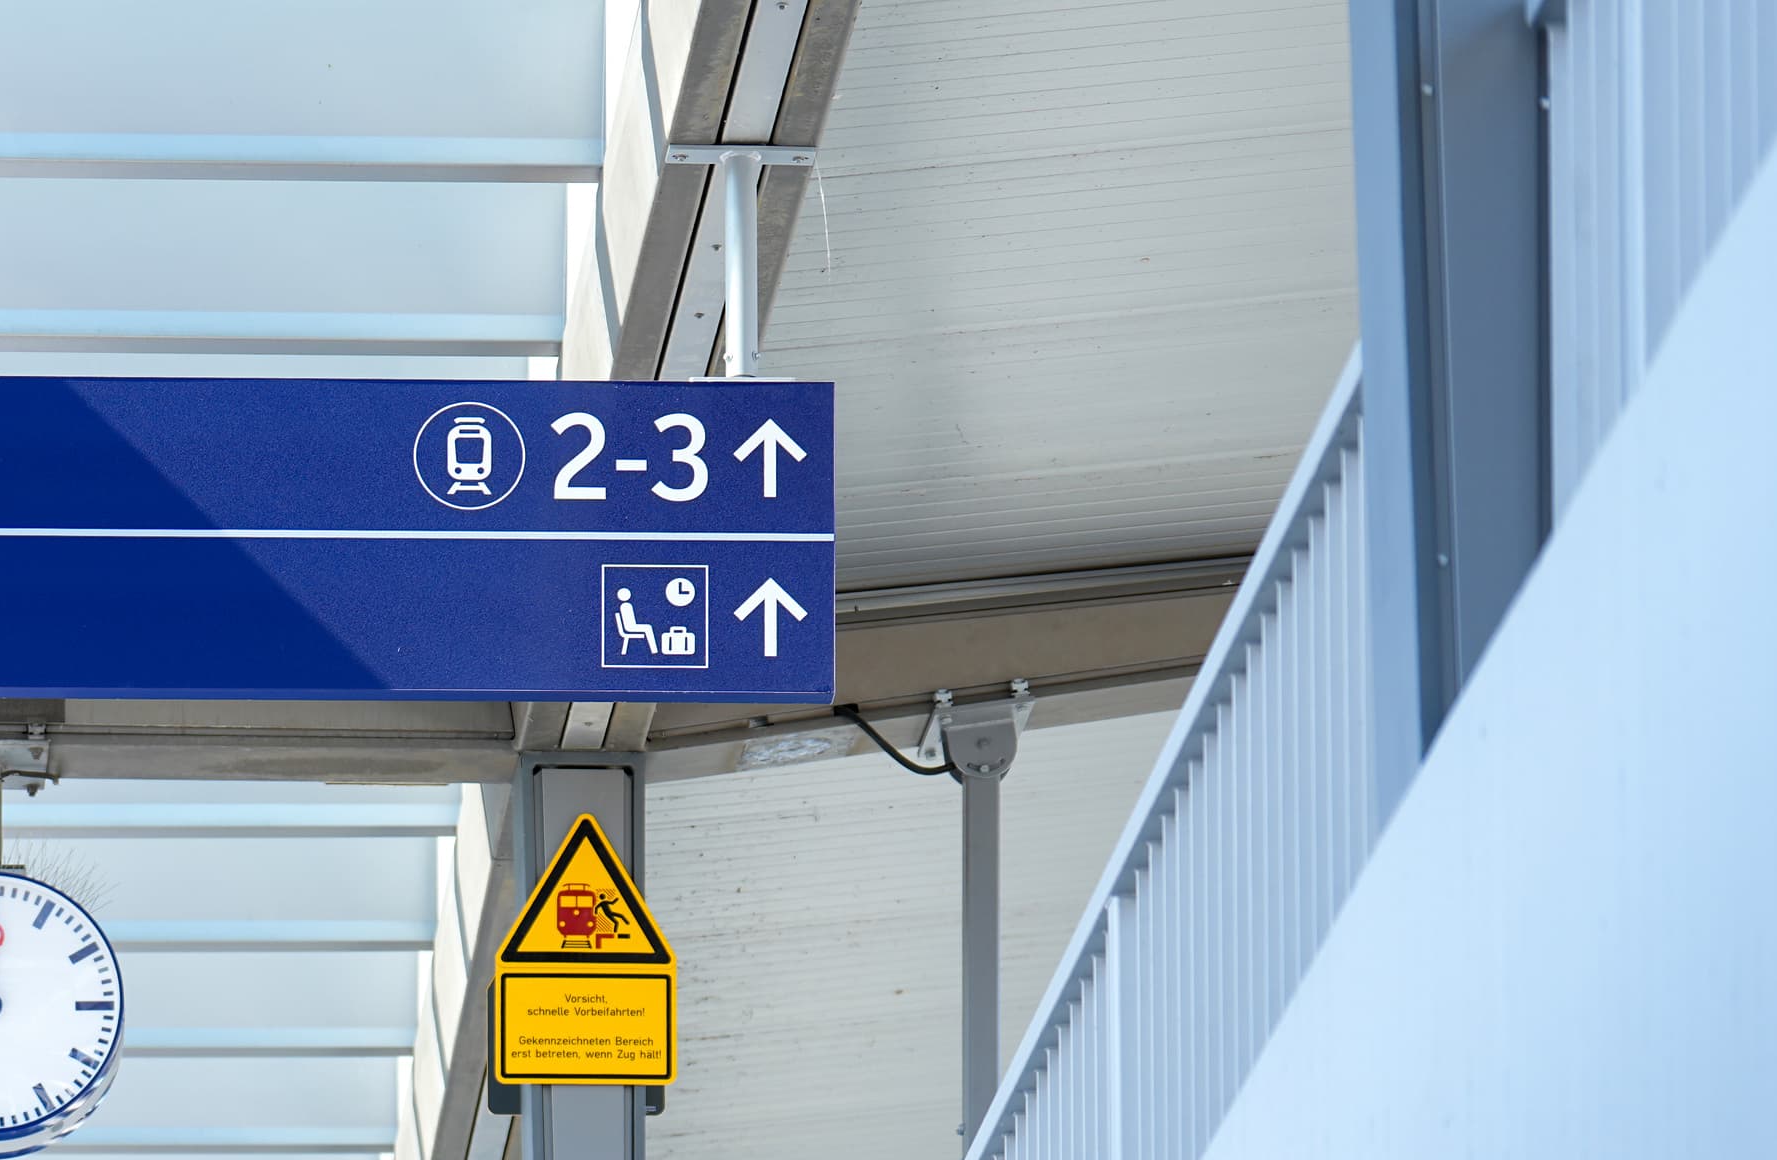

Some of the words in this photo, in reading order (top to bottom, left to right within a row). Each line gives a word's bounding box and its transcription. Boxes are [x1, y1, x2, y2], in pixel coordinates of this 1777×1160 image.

[550, 411, 709, 502] 2-3
[564, 993, 608, 1004] Vorsicht,
[527, 1007, 570, 1016] schnelle
[574, 1007, 646, 1017] Vorbeifahrten!
[518, 1036, 611, 1046] Gekennzeichneten
[615, 1036, 654, 1047] Bereich
[511, 1050, 531, 1059] erst
[535, 1049, 582, 1060] betreten,
[585, 1051, 613, 1060] wenn
[617, 1050, 636, 1062] Zug
[639, 1049, 662, 1060] hält!
